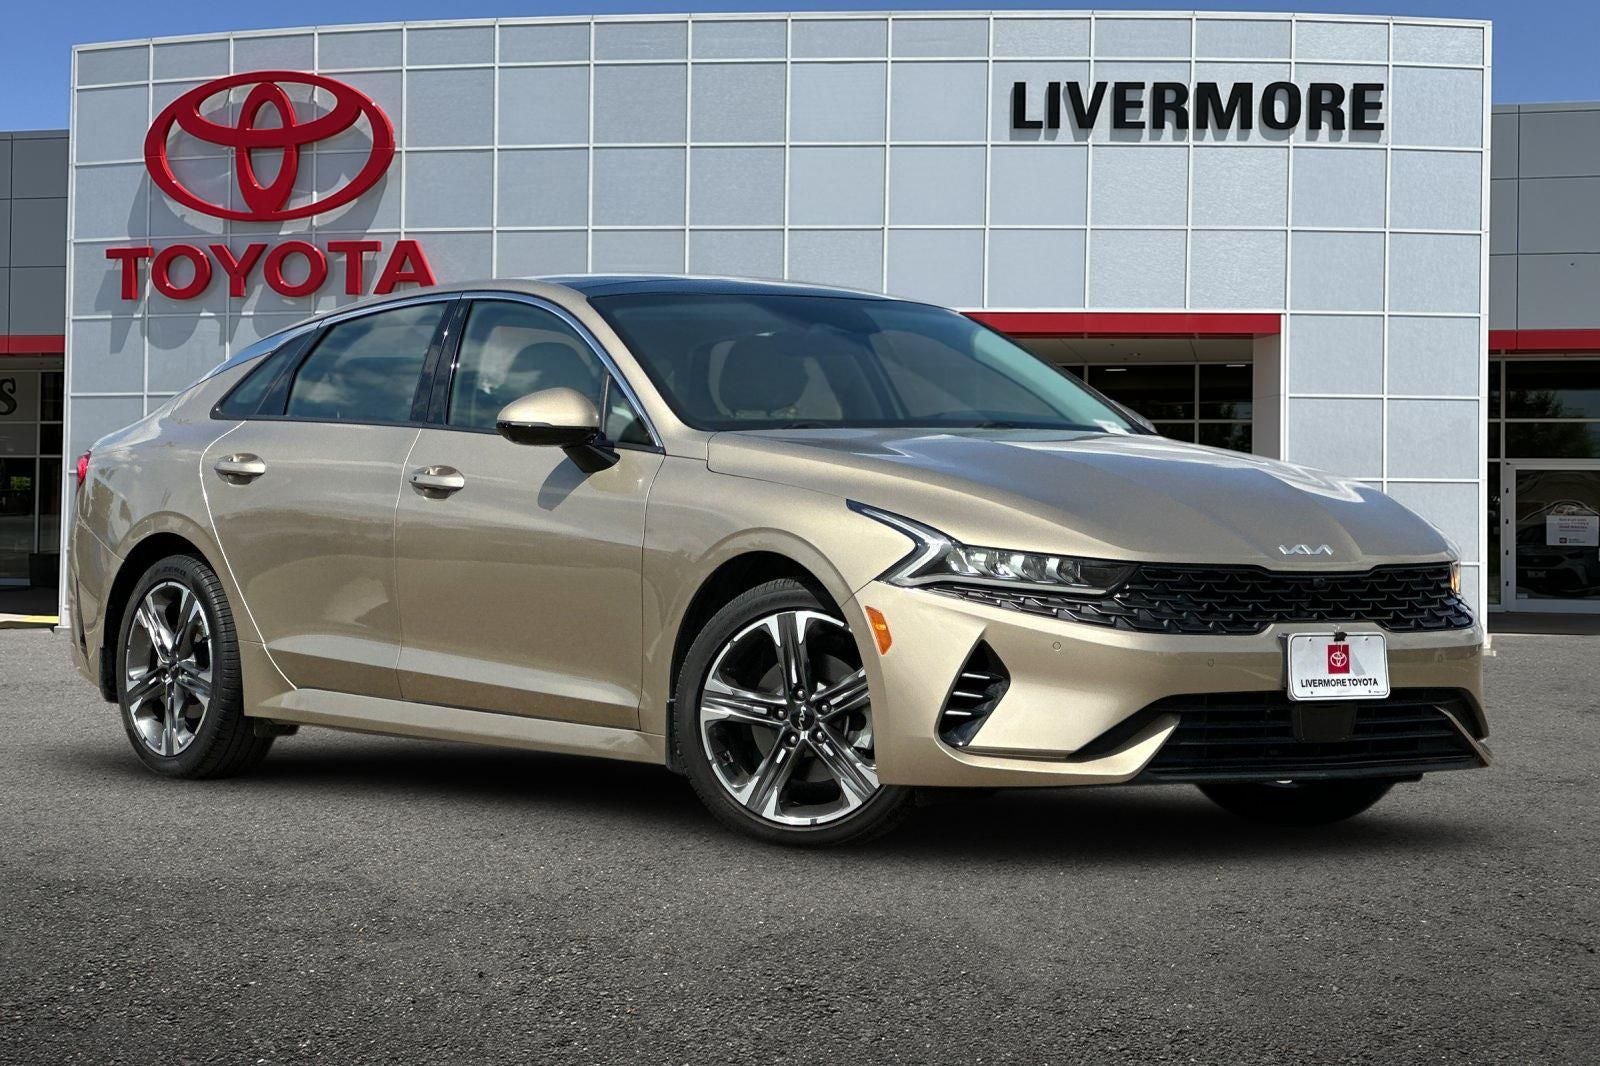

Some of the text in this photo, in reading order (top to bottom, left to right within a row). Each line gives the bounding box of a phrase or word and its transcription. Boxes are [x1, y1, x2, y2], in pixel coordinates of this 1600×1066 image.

[1012, 81, 1385, 131] LIVERMORE
[106, 240, 436, 300] TOYOTA
[1301, 678, 1379, 688] LIVERMORE TOYOTA
